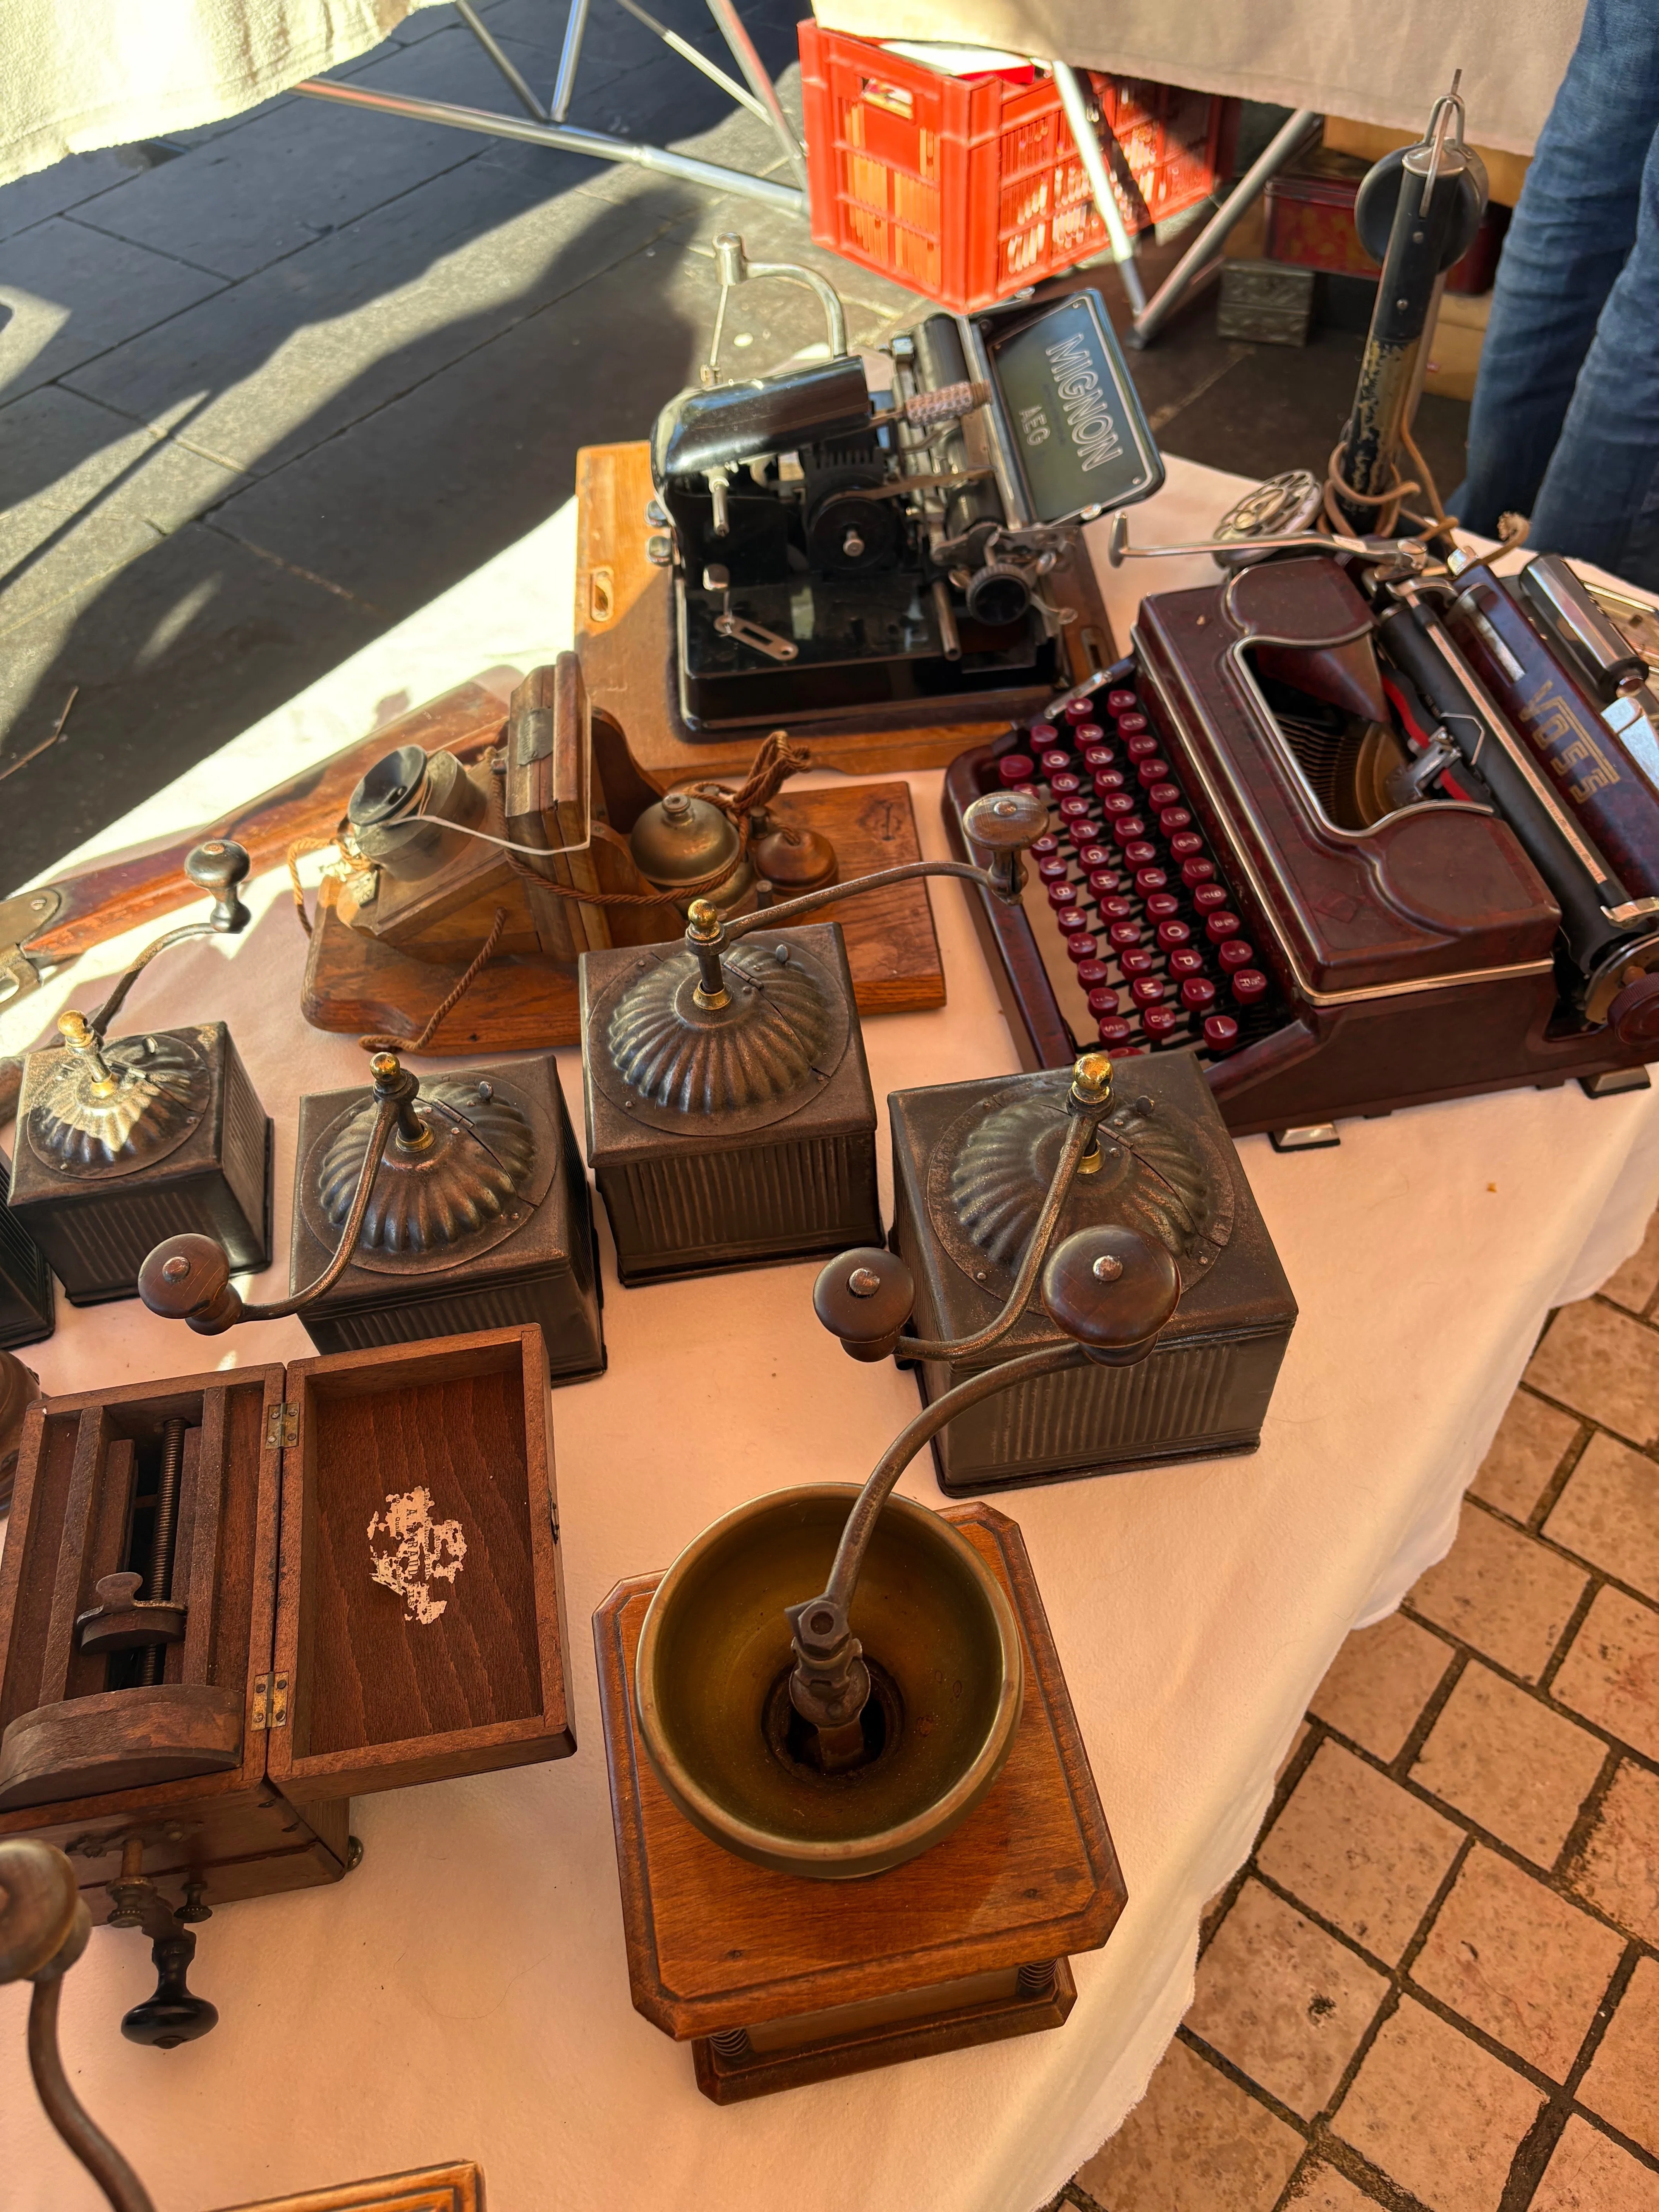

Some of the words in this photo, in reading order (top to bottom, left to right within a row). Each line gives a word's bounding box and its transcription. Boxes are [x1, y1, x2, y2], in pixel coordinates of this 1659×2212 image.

[1018, 404, 1051, 446] AEG
[1045, 333, 1123, 472] MIGNON
[1518, 680, 1621, 805] VOSS
[1047, 861, 1061, 870] V
[1056, 887, 1070, 896] B
[1065, 912, 1080, 922] N
[1077, 826, 1092, 834] F
[1087, 850, 1103, 859] G
[1097, 875, 1112, 885] H
[1108, 902, 1123, 911] J
[1118, 928, 1133, 938] K
[1130, 956, 1144, 965] L
[1140, 982, 1157, 994] M
[1112, 799, 1126, 807] R
[1124, 823, 1140, 833] T
[1135, 847, 1148, 856] Y
[1144, 873, 1159, 883] U
[1167, 926, 1182, 937] O
[1178, 955, 1194, 965] P
